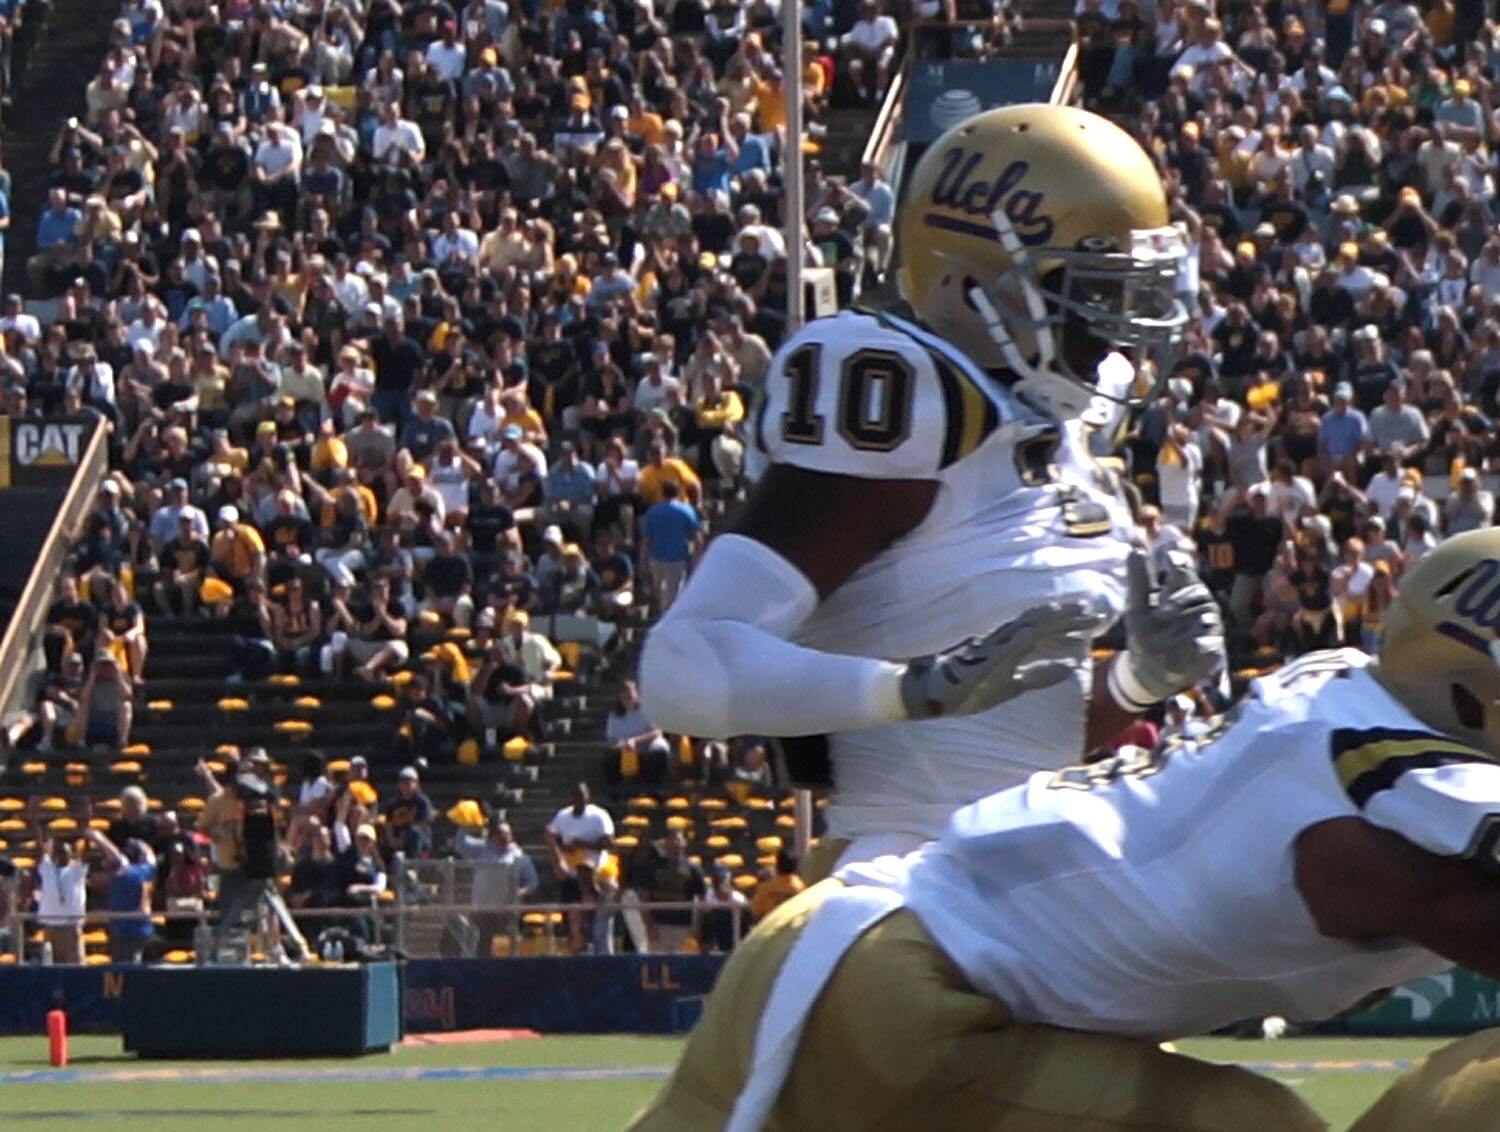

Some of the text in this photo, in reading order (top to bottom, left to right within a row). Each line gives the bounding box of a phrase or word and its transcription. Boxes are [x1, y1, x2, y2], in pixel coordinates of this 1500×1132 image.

[924, 147, 1055, 246] Ucla
[782, 342, 916, 452] 10
[16, 423, 83, 466] CAT
[641, 964, 681, 989] LL
